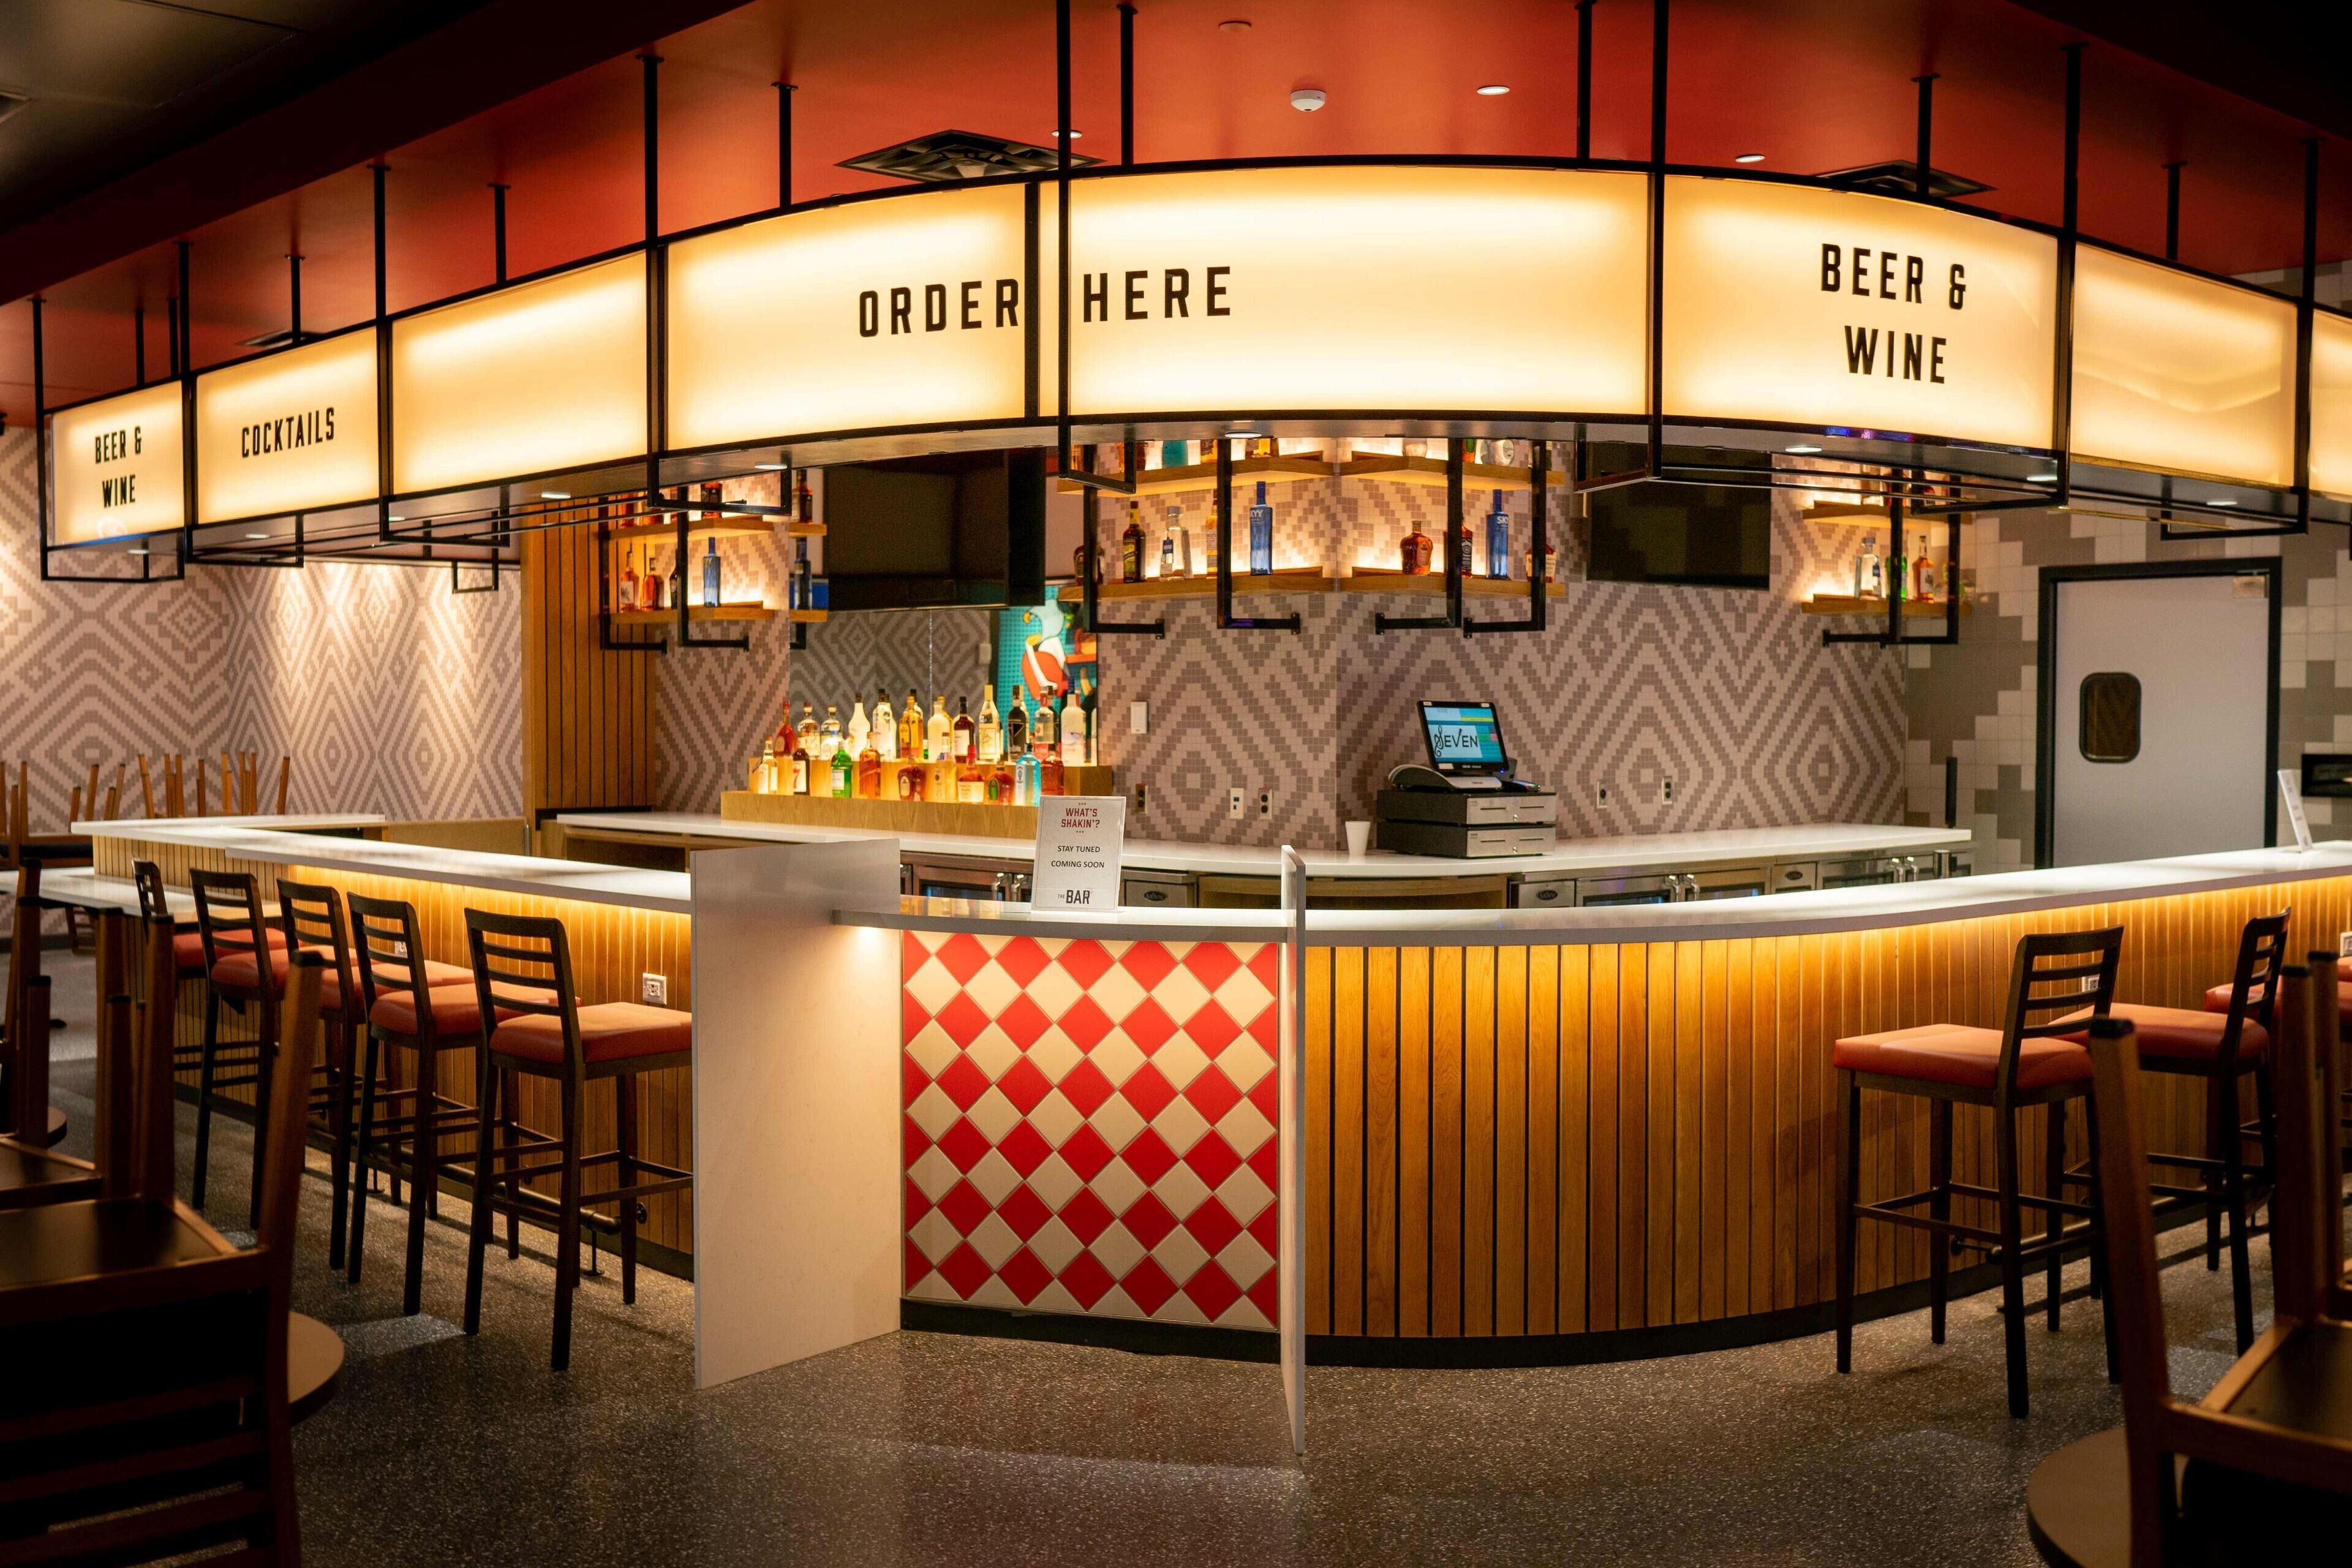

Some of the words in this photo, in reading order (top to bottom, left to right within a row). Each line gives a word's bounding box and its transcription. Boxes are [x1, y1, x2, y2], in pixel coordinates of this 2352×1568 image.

[1820, 243, 1924, 304] BEER
[1948, 263, 1967, 311] &
[859, 278, 1019, 337] ORDER
[1083, 266, 1231, 323] HERE
[1844, 325, 1947, 384] WINE
[95, 429, 127, 464] BEER
[134, 426, 142, 455] &
[241, 407, 335, 459] COCKTAILS
[102, 474, 136, 508] WINE
[1434, 725, 1479, 757] SEVEN
[1061, 818, 1100, 828] SHAKIN'?
[1065, 808, 1098, 817] WHAT'S
[1066, 889, 1090, 905] BAR
